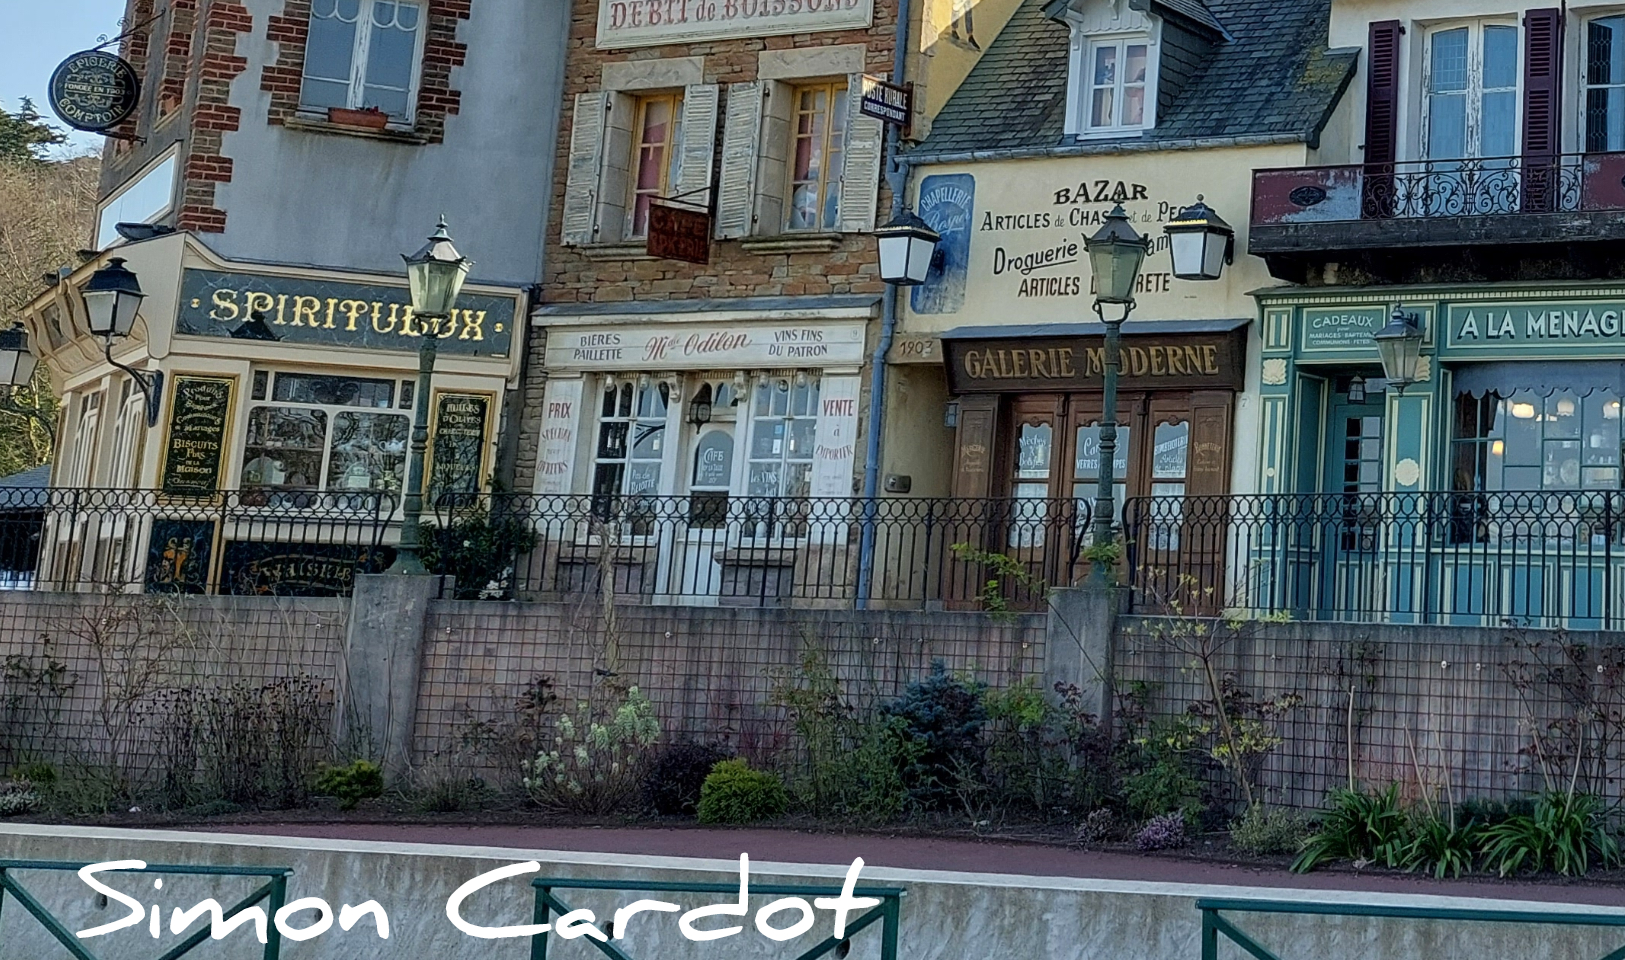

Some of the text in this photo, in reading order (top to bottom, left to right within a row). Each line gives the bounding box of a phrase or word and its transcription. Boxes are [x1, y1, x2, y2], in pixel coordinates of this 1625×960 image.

[60, 98, 124, 122] COMPTOIR
[921, 187, 972, 212] CHAPELLERIE
[1053, 180, 1149, 205] BAZAR
[980, 210, 1050, 232] ARTICLES
[1054, 216, 1065, 228] de
[1069, 207, 1110, 227] CHAS
[1141, 210, 1152, 223] de
[993, 238, 1078, 275] Droguerie
[1018, 276, 1080, 298] ARTICLES
[1312, 314, 1374, 328] CADEAUX
[1457, 309, 1479, 339] A
[1486, 309, 1516, 339] LA
[683, 331, 752, 357] Odilon
[774, 329, 823, 343] VINS FINS
[573, 348, 622, 361] PAILLETTE
[768, 344, 828, 358] DU PATRON
[964, 347, 1076, 379] GALERIE
[548, 402, 572, 419] PRIX
[823, 399, 854, 417] VENTE
[173, 439, 218, 450] BISCUITS
[176, 465, 212, 474] Maison
[1076, 459, 1098, 469] VERRES
